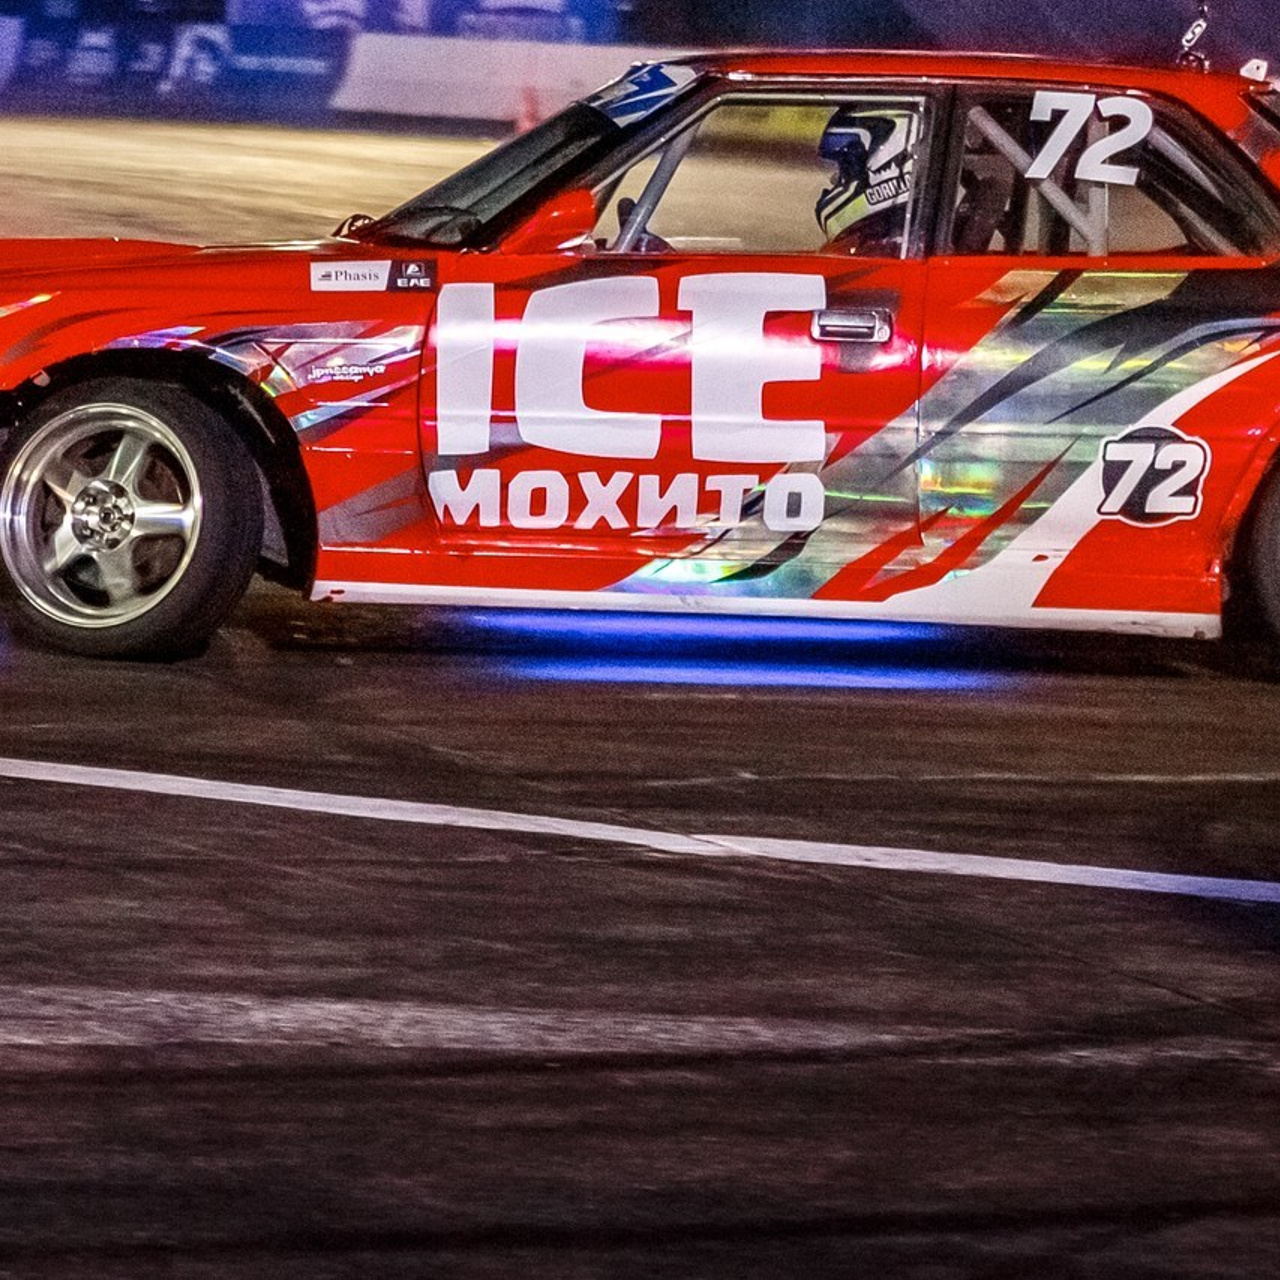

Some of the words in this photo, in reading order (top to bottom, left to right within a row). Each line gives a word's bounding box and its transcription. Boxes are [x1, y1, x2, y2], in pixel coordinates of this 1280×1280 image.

[1024, 91, 1154, 186] 72
[334, 269, 380, 281] Phasis
[436, 272, 826, 463] ICE
[429, 468, 824, 532] МОХИТО
[1100, 442, 1206, 514] 72
